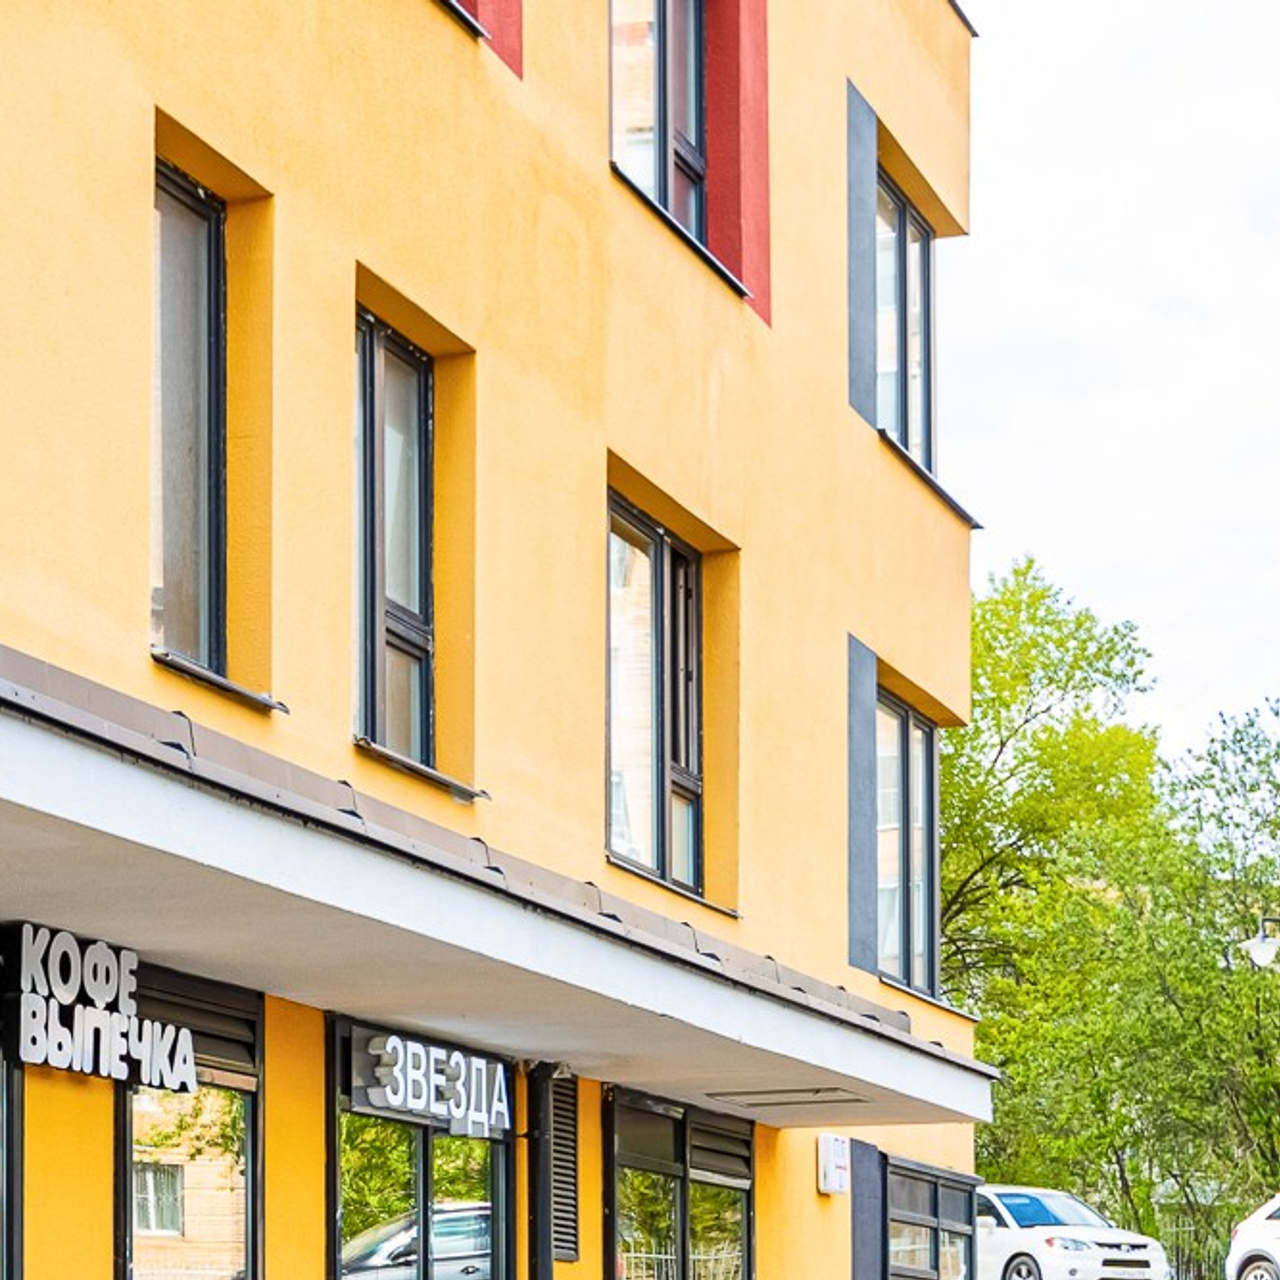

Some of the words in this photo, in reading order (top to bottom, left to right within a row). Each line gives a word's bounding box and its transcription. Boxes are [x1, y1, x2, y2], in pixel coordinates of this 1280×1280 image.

[20, 922, 139, 1017] КОФЕ
[19, 992, 197, 1094] ВЫПЕЧКА
[383, 1034, 511, 1139] ЗВЕЗДА
